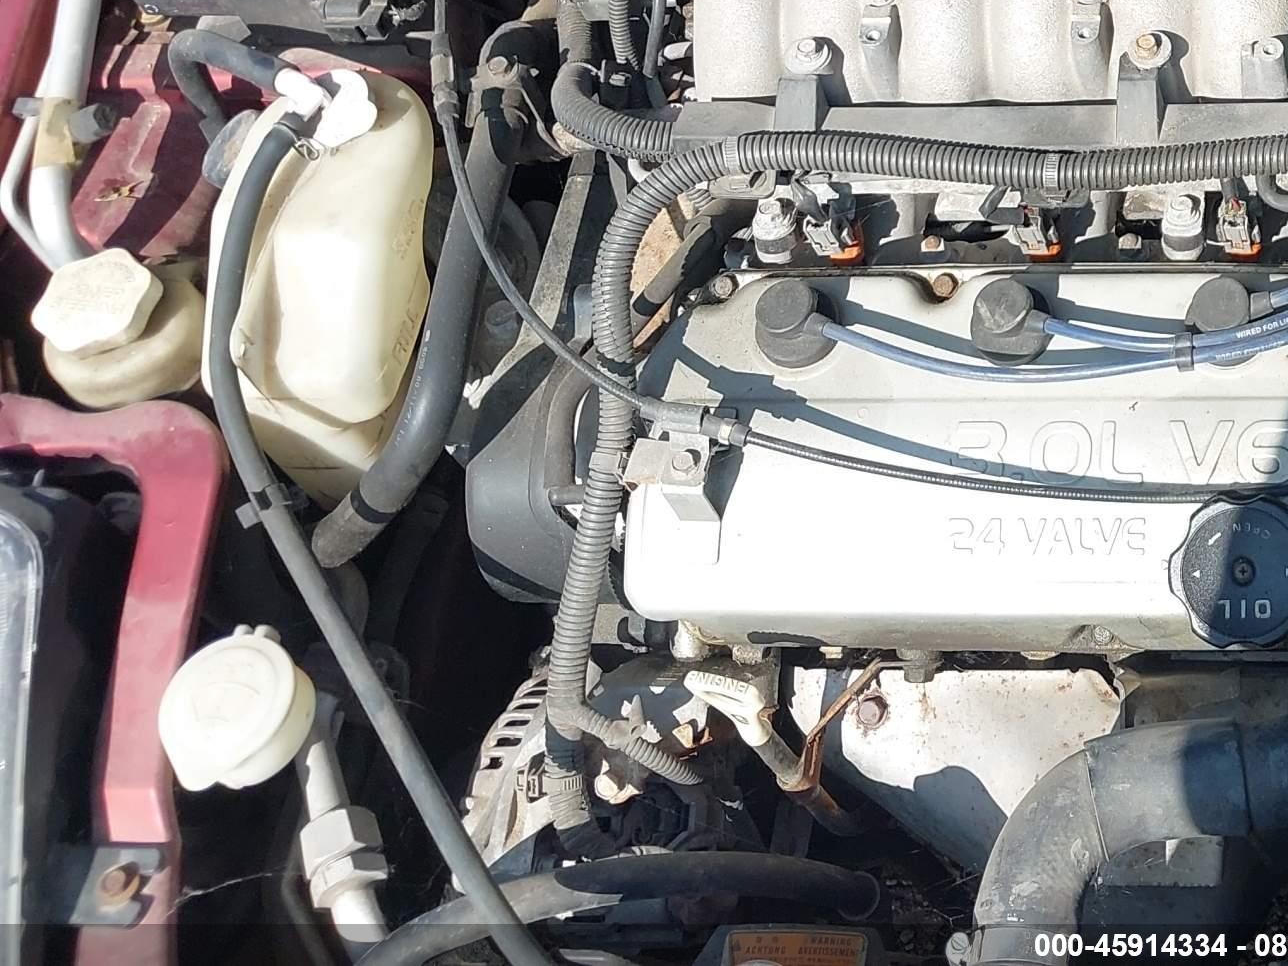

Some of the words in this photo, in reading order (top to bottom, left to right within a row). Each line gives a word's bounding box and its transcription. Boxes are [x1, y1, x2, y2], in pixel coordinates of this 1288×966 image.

[1235, 327, 1262, 339] WIRED
[1262, 321, 1280, 332] FOR
[948, 517, 1005, 556] 24
[1017, 517, 1147, 556] VALVE
[1232, 522, 1272, 540] OPEN
[1217, 599, 1272, 618] OIL
[688, 671, 750, 694] ENGINE
[744, 945, 787, 955] ACHTUNG
